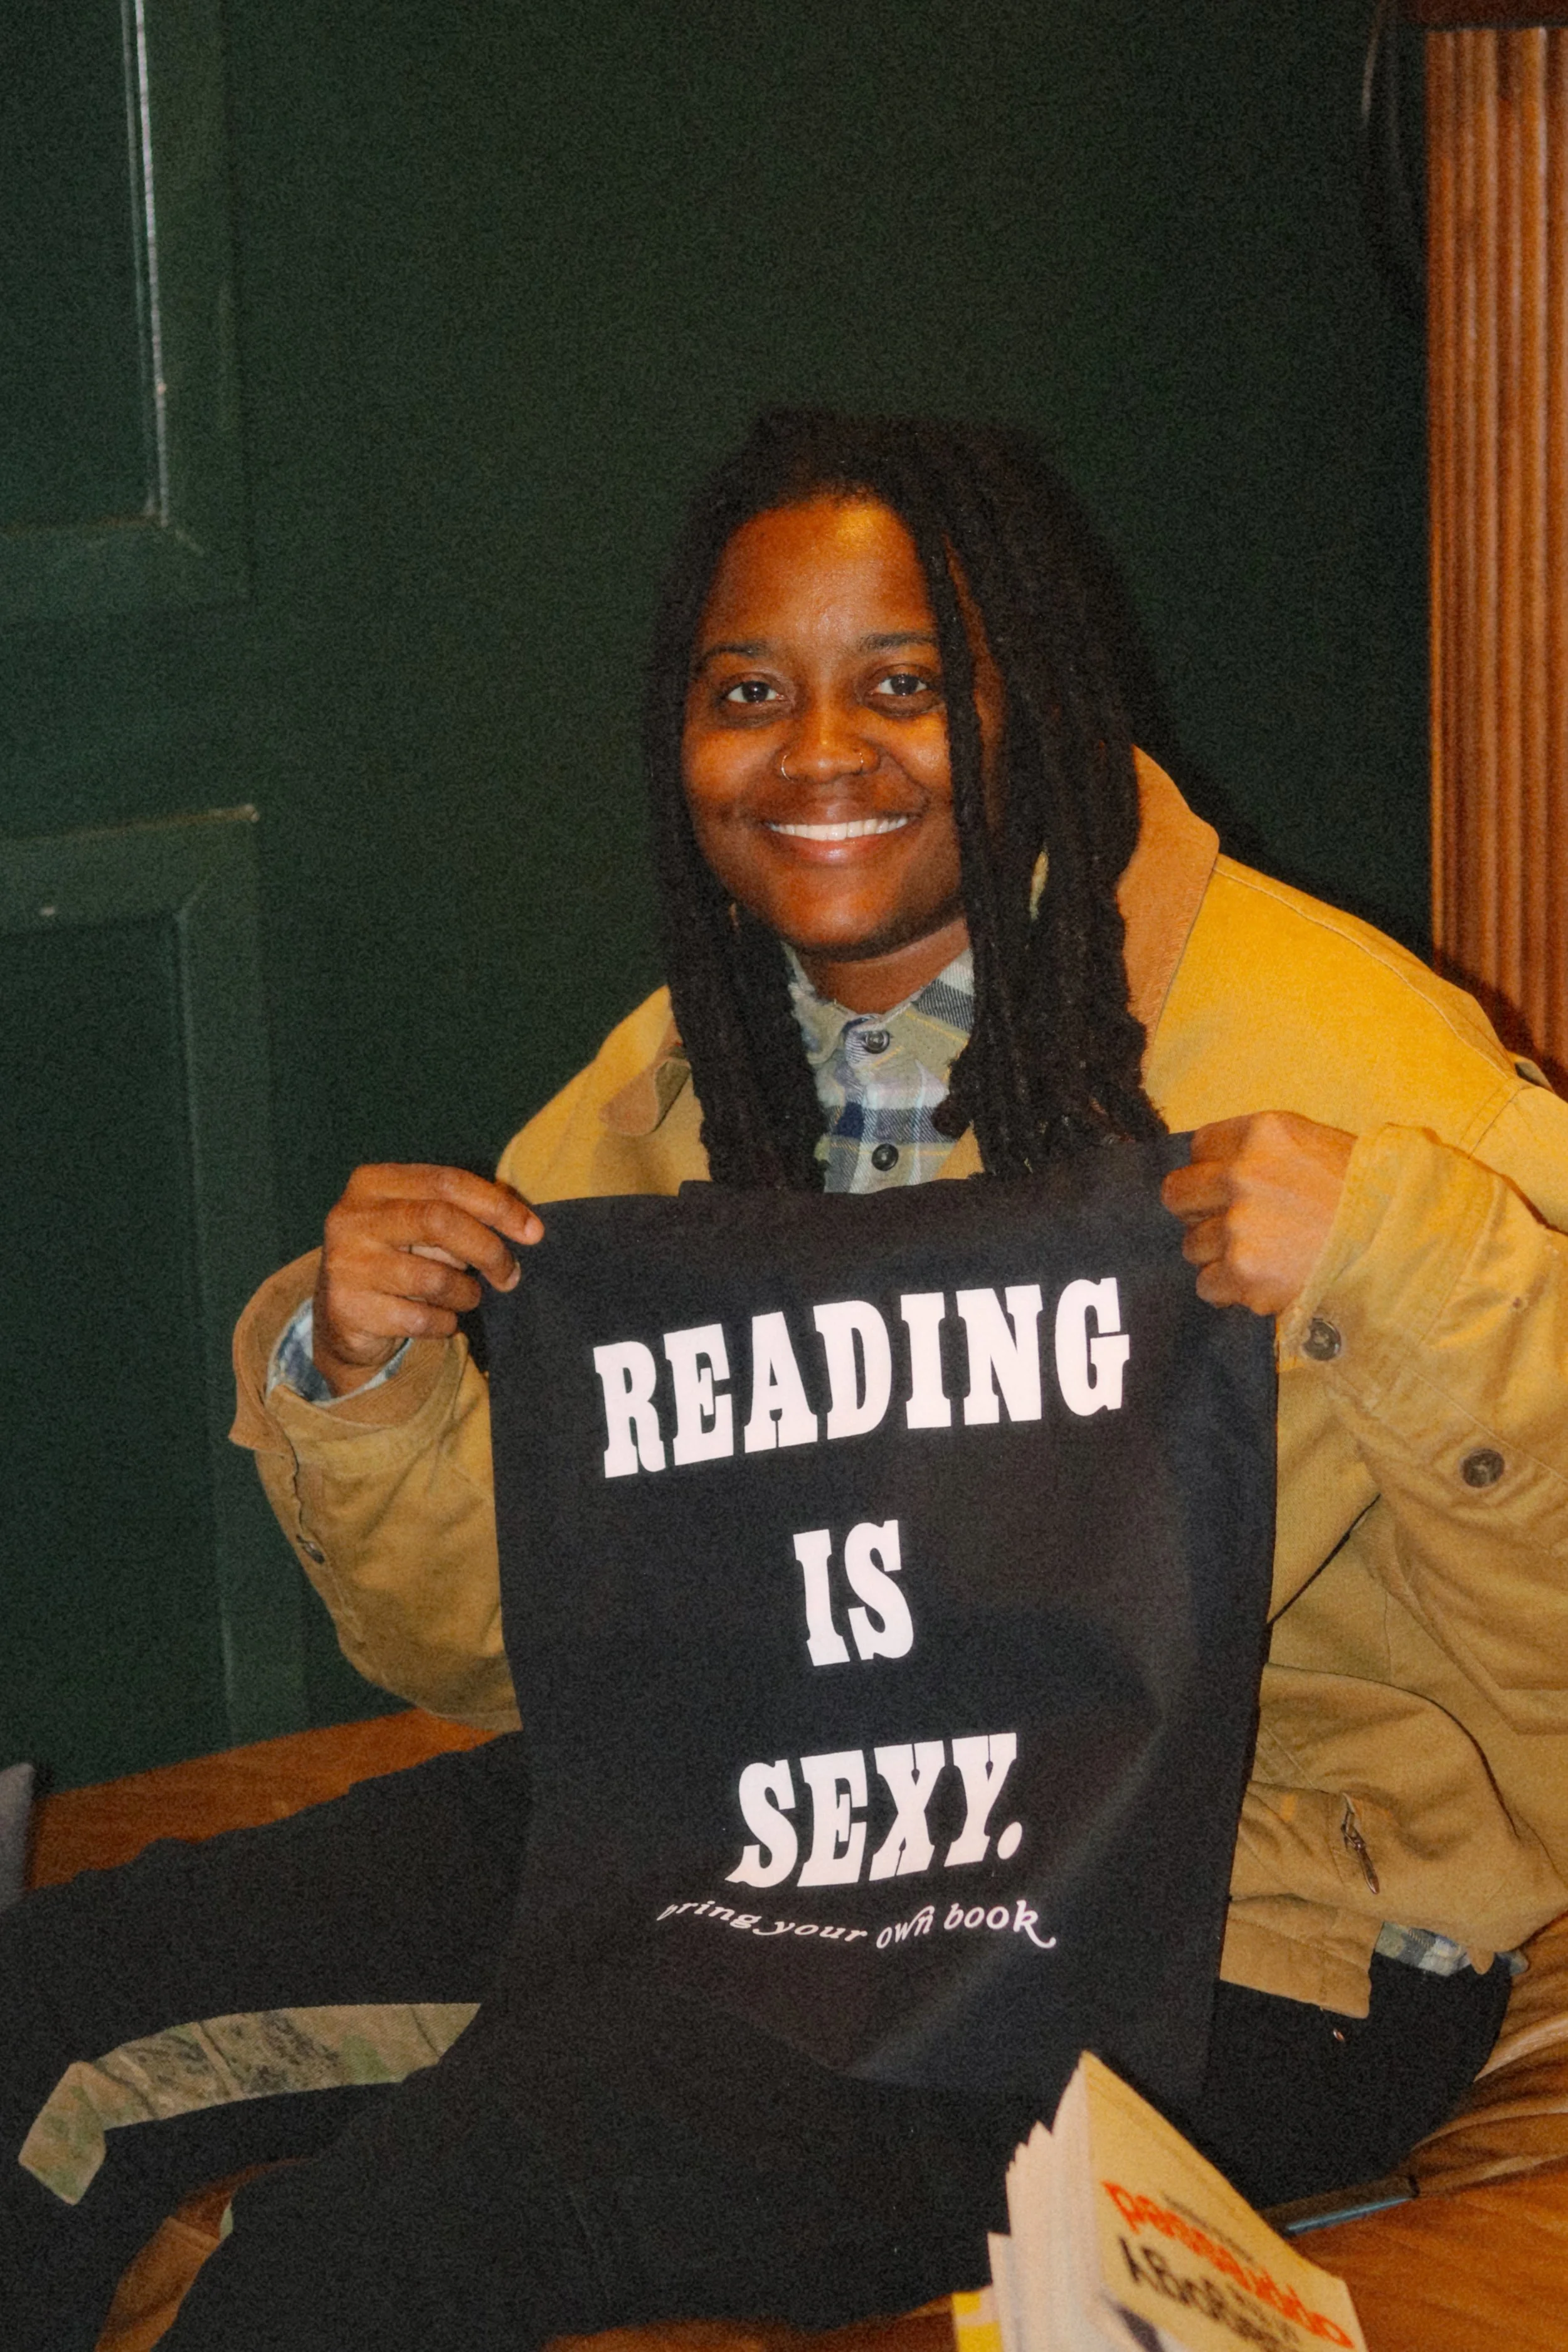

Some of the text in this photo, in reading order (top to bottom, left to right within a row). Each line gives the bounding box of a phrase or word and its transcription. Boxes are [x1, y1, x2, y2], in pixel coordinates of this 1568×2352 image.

[593, 1276, 1131, 1479] READING
[792, 1519, 914, 1667] IS
[724, 1732, 1024, 1888] SEXY.
[752, 1920, 868, 1942] your
[876, 1905, 936, 1949] own
[943, 1899, 1057, 1949] book
